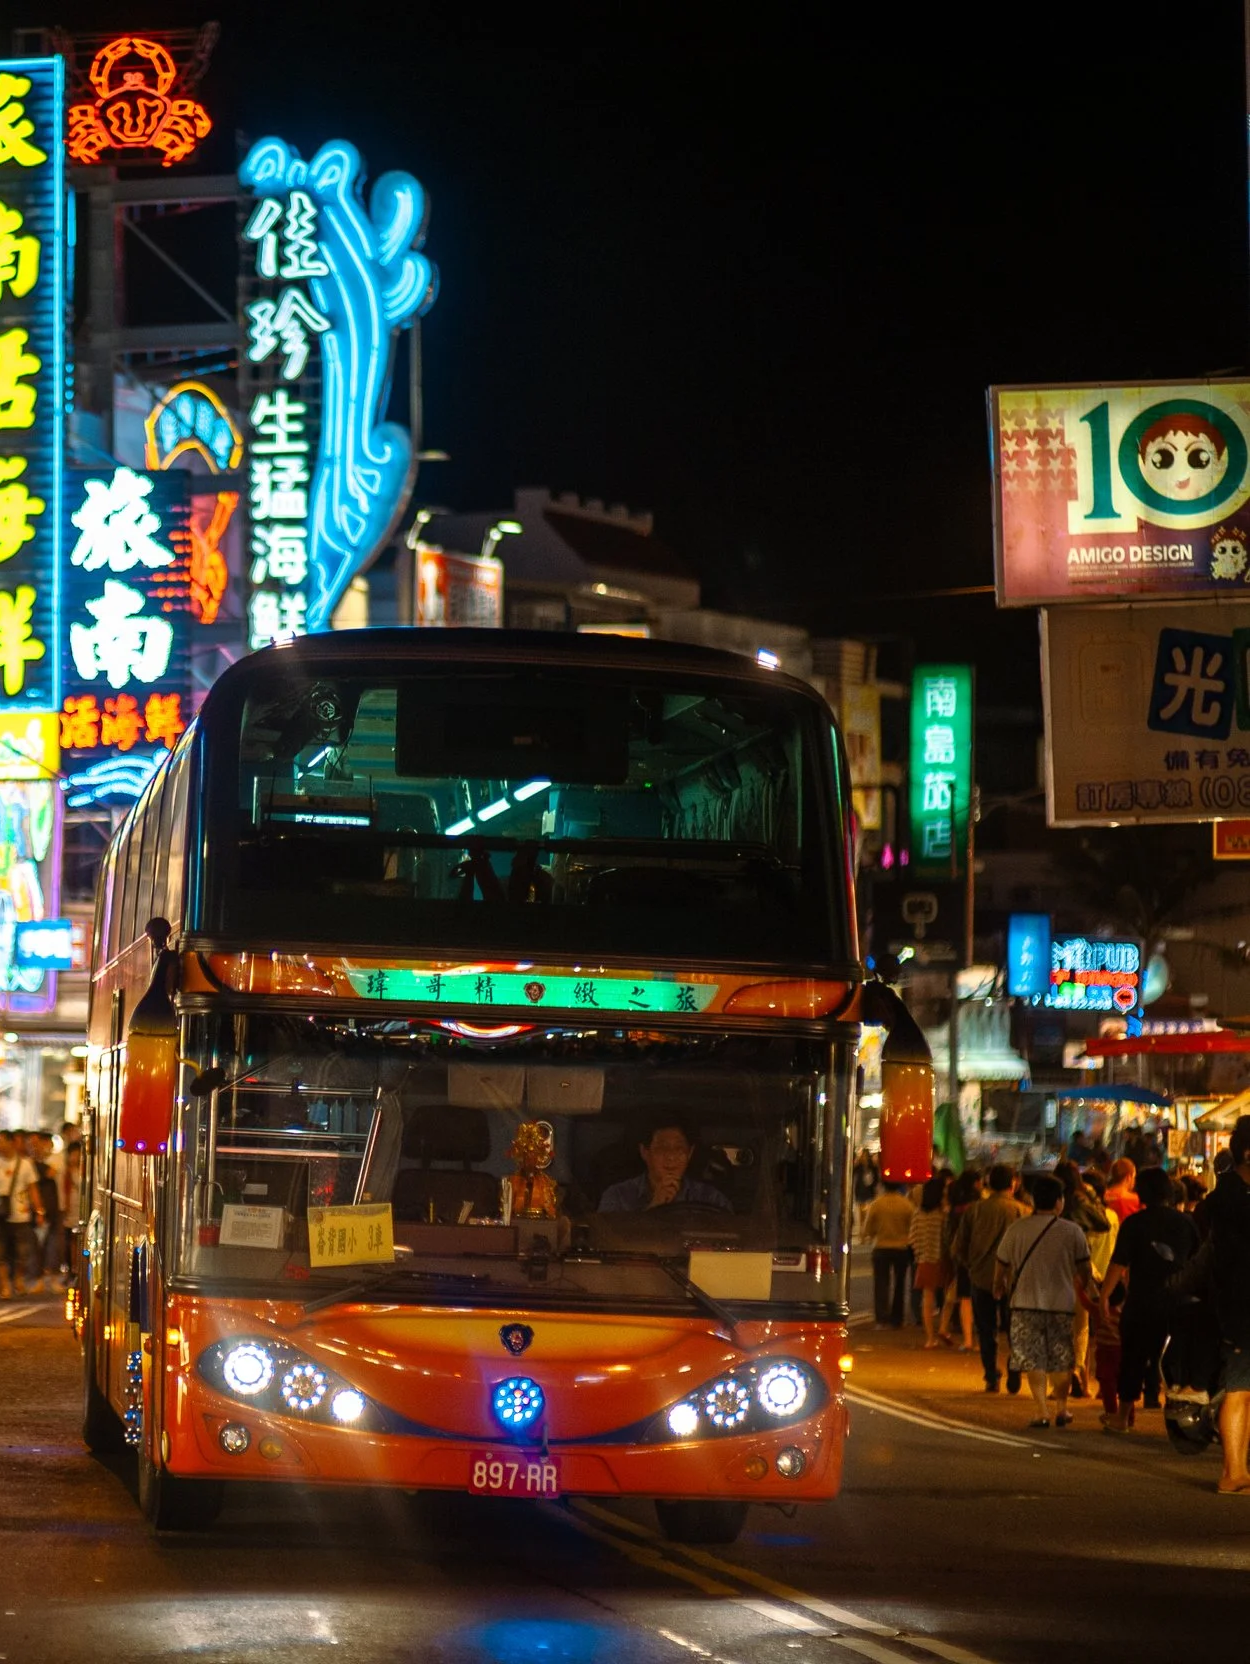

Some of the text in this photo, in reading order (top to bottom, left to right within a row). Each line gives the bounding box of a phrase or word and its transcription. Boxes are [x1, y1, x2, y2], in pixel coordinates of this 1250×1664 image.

[1067, 544, 1194, 565] AMIGO DESIGN
[69, 465, 177, 692] 旅南
[473, 1461, 557, 1492] 897-RR
